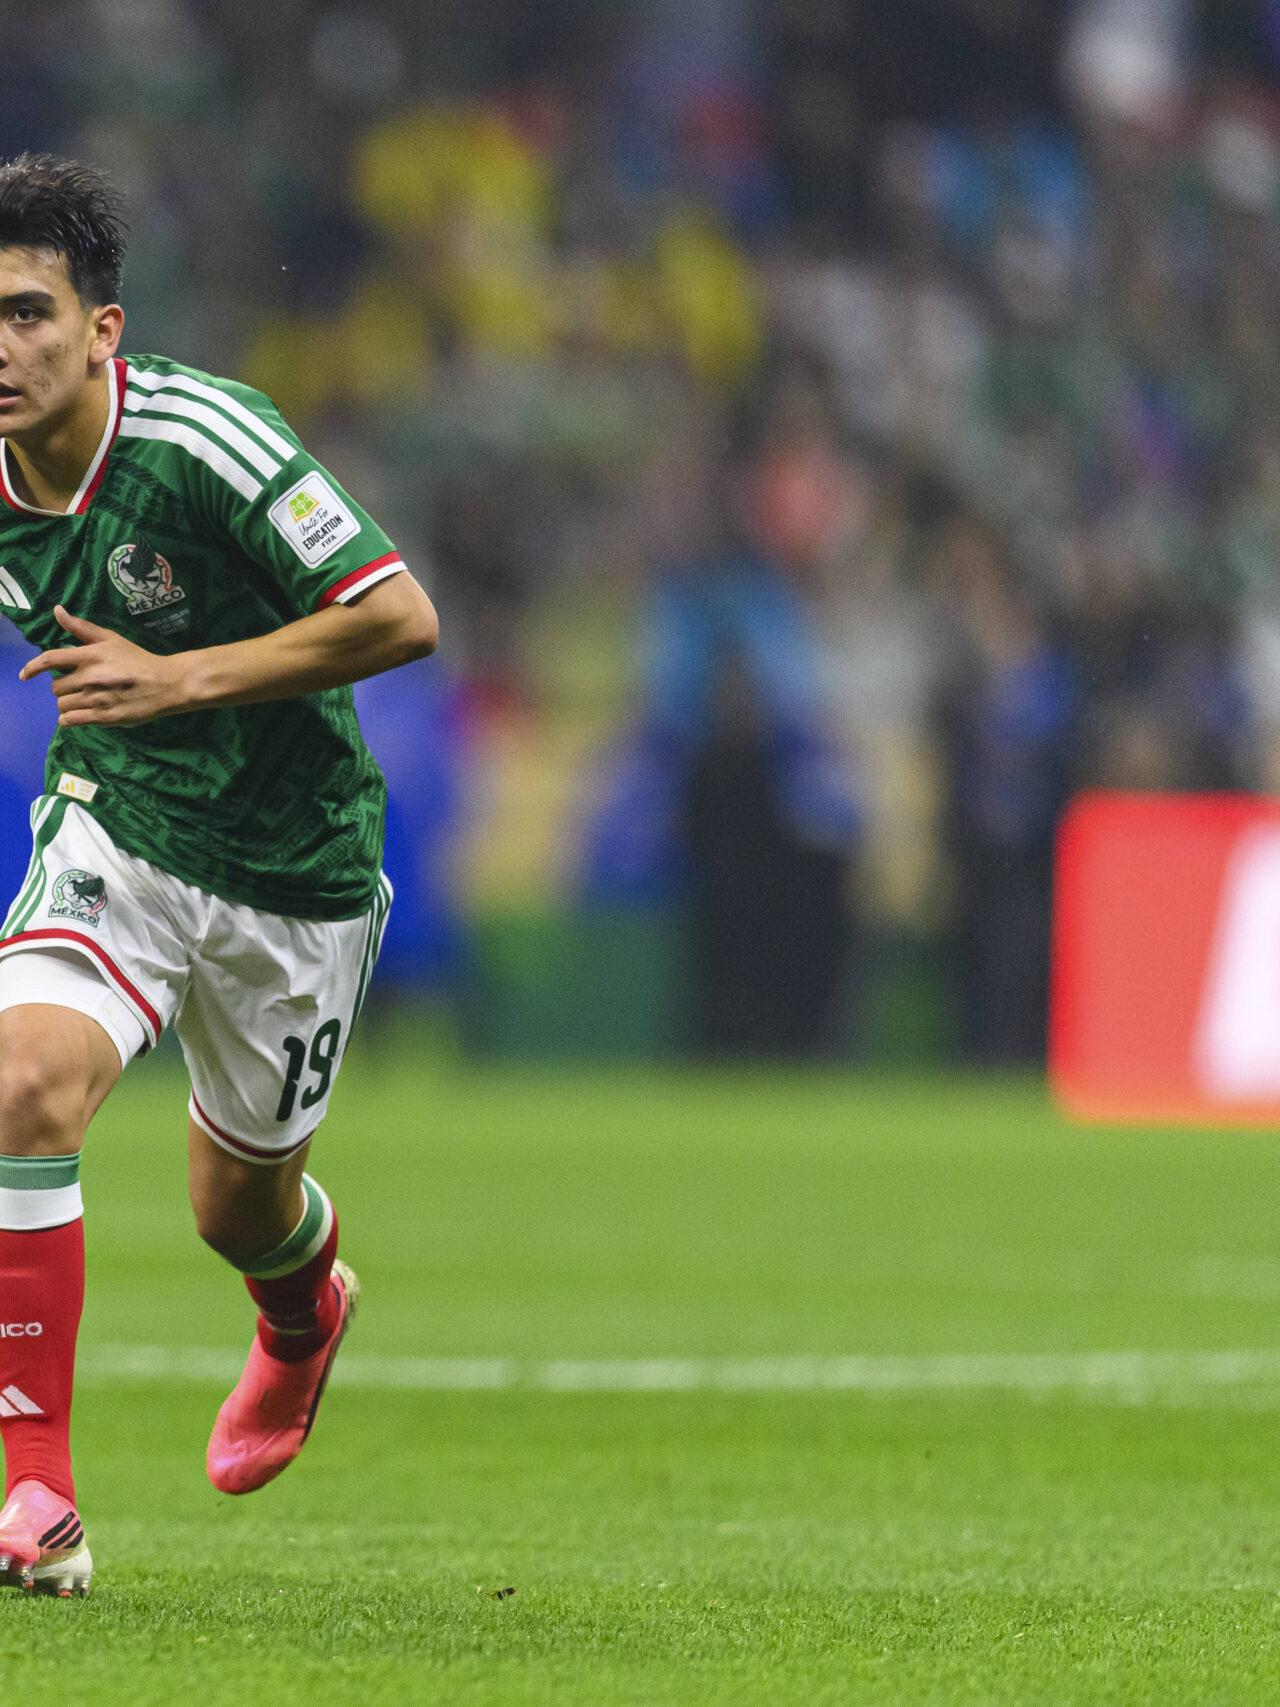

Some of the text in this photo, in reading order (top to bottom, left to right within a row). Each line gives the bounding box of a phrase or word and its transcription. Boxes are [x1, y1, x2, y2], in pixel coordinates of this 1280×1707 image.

[298, 507, 329, 536] Unite For
[302, 514, 344, 550] EDUCATION
[321, 535, 337, 548] FIFA
[129, 589, 182, 613] MÉXICO
[51, 906, 97, 924] MÉXICO
[276, 1018, 341, 1122] 19
